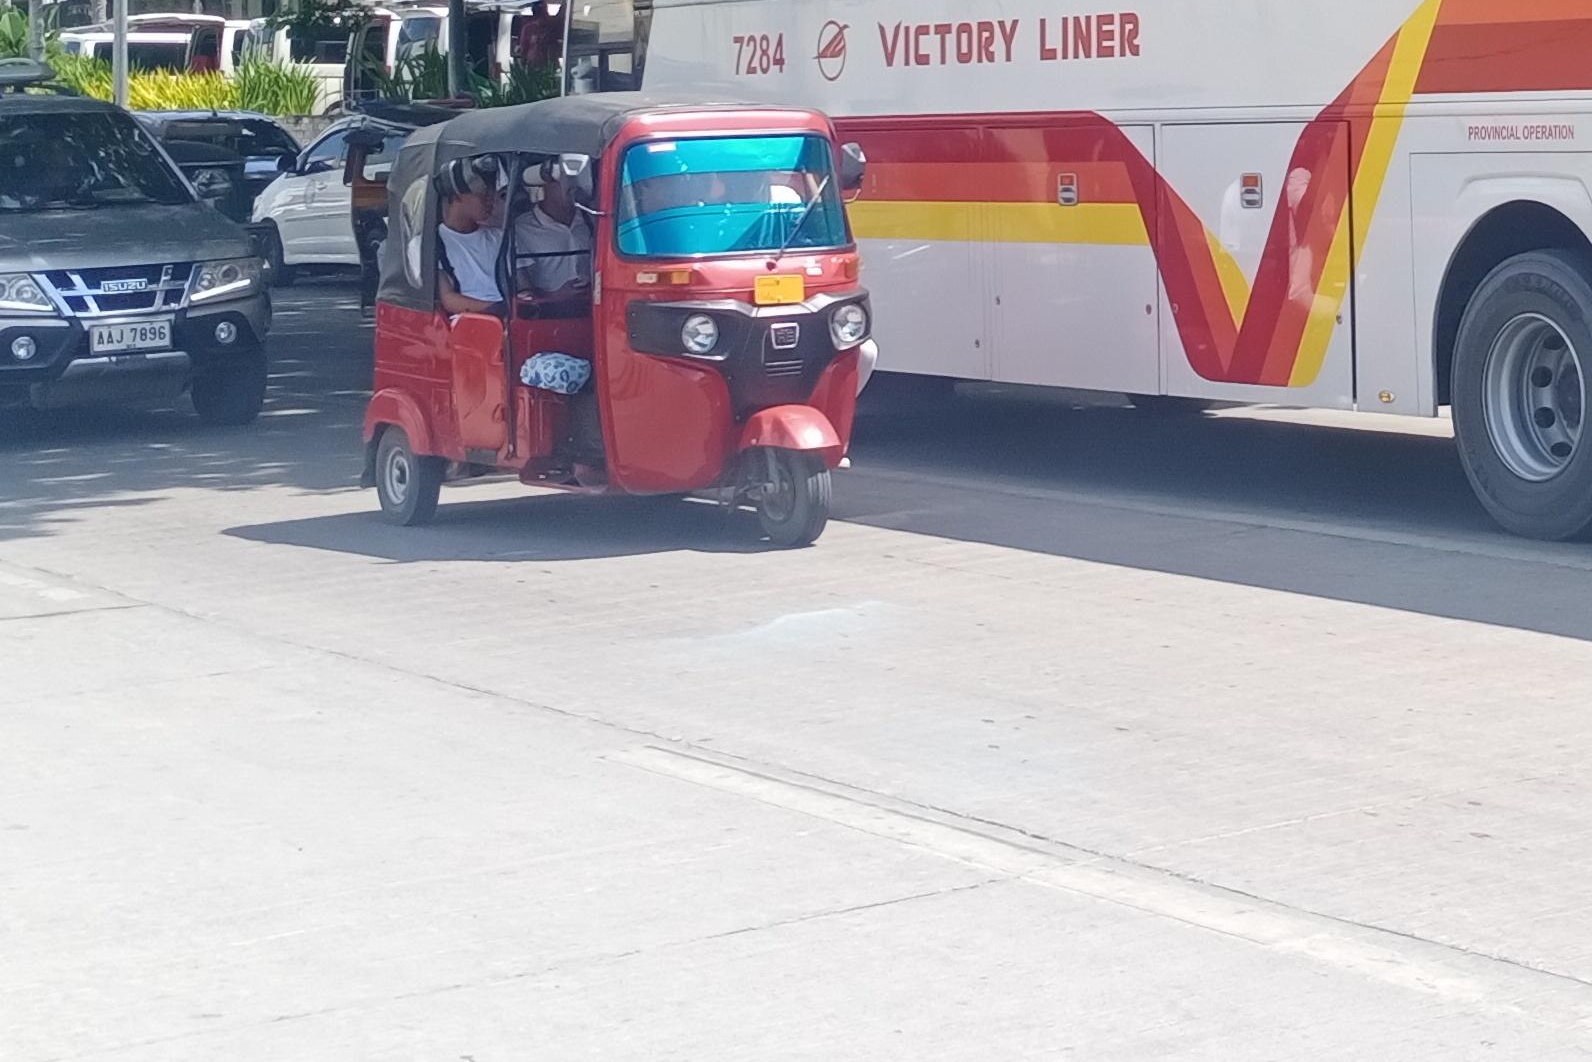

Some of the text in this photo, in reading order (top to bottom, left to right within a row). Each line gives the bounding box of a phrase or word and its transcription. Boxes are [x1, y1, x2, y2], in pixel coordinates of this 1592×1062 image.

[733, 12, 1141, 76] 7284 VICTORY LINER
[1468, 124, 1575, 141] PROVINCIAL OPERATION
[103, 282, 146, 292] ISUZU
[97, 325, 167, 345] AAJ 7896
